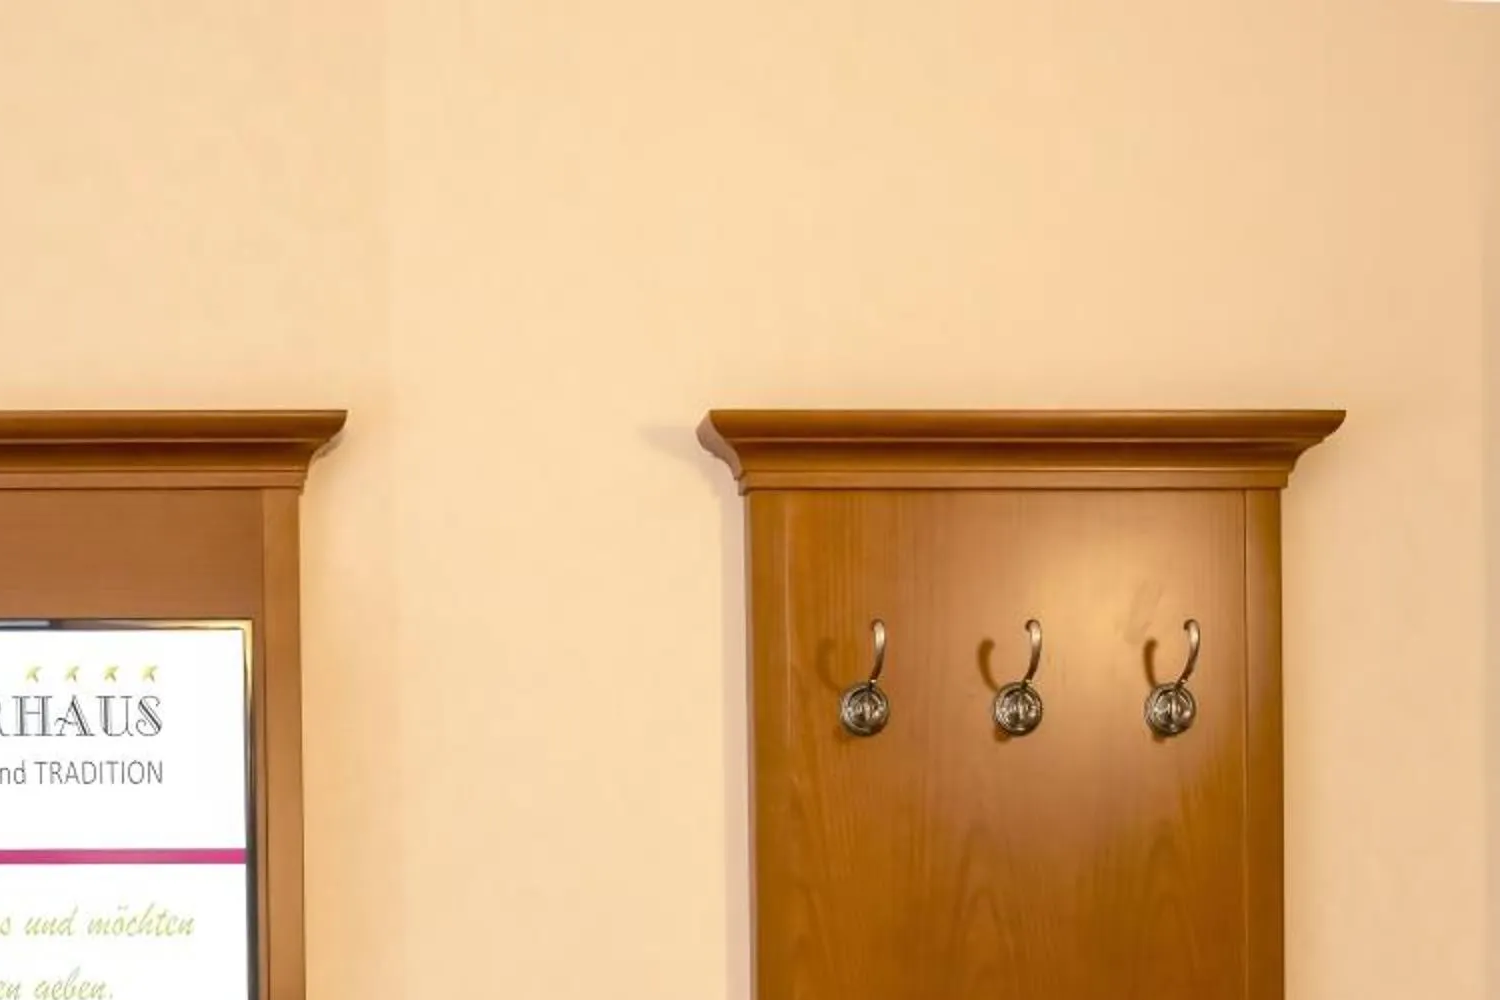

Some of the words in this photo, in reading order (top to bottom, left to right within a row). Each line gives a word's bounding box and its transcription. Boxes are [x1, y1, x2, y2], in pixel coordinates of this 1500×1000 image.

[34, 760, 163, 785] TRADITION
[24, 906, 78, 937] und
[87, 903, 195, 938] möchten
